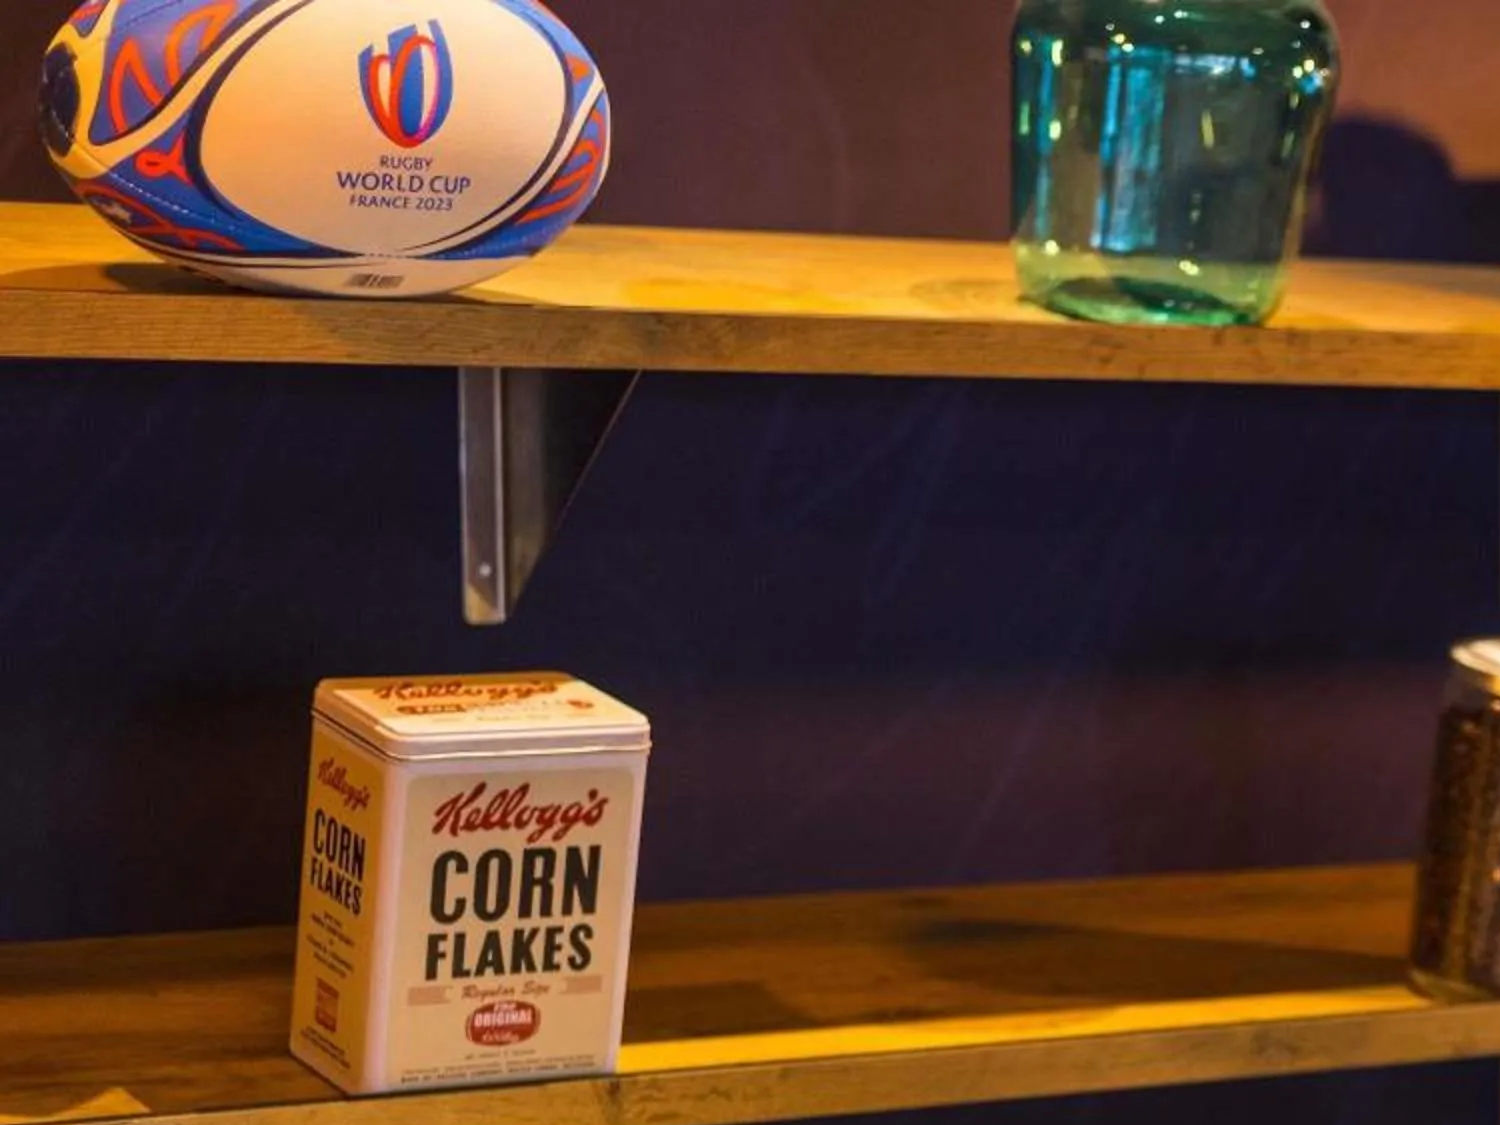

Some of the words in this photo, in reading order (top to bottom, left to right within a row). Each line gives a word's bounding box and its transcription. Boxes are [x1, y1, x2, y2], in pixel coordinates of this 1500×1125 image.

[336, 171, 424, 193] WORLD
[429, 175, 472, 194] CUP
[379, 154, 433, 172] RUGBY
[349, 194, 412, 210] FRANCE
[415, 197, 453, 211] 2023
[373, 681, 558, 701] Kellogg's
[316, 758, 371, 811] Kellogg's
[432, 781, 609, 843] Kellogg's
[313, 808, 366, 882] CORN
[310, 856, 361, 916] FLAKES
[430, 845, 602, 925] CORN
[425, 923, 593, 980] FLAKES
[473, 1008, 533, 1028] ORIGINAL
